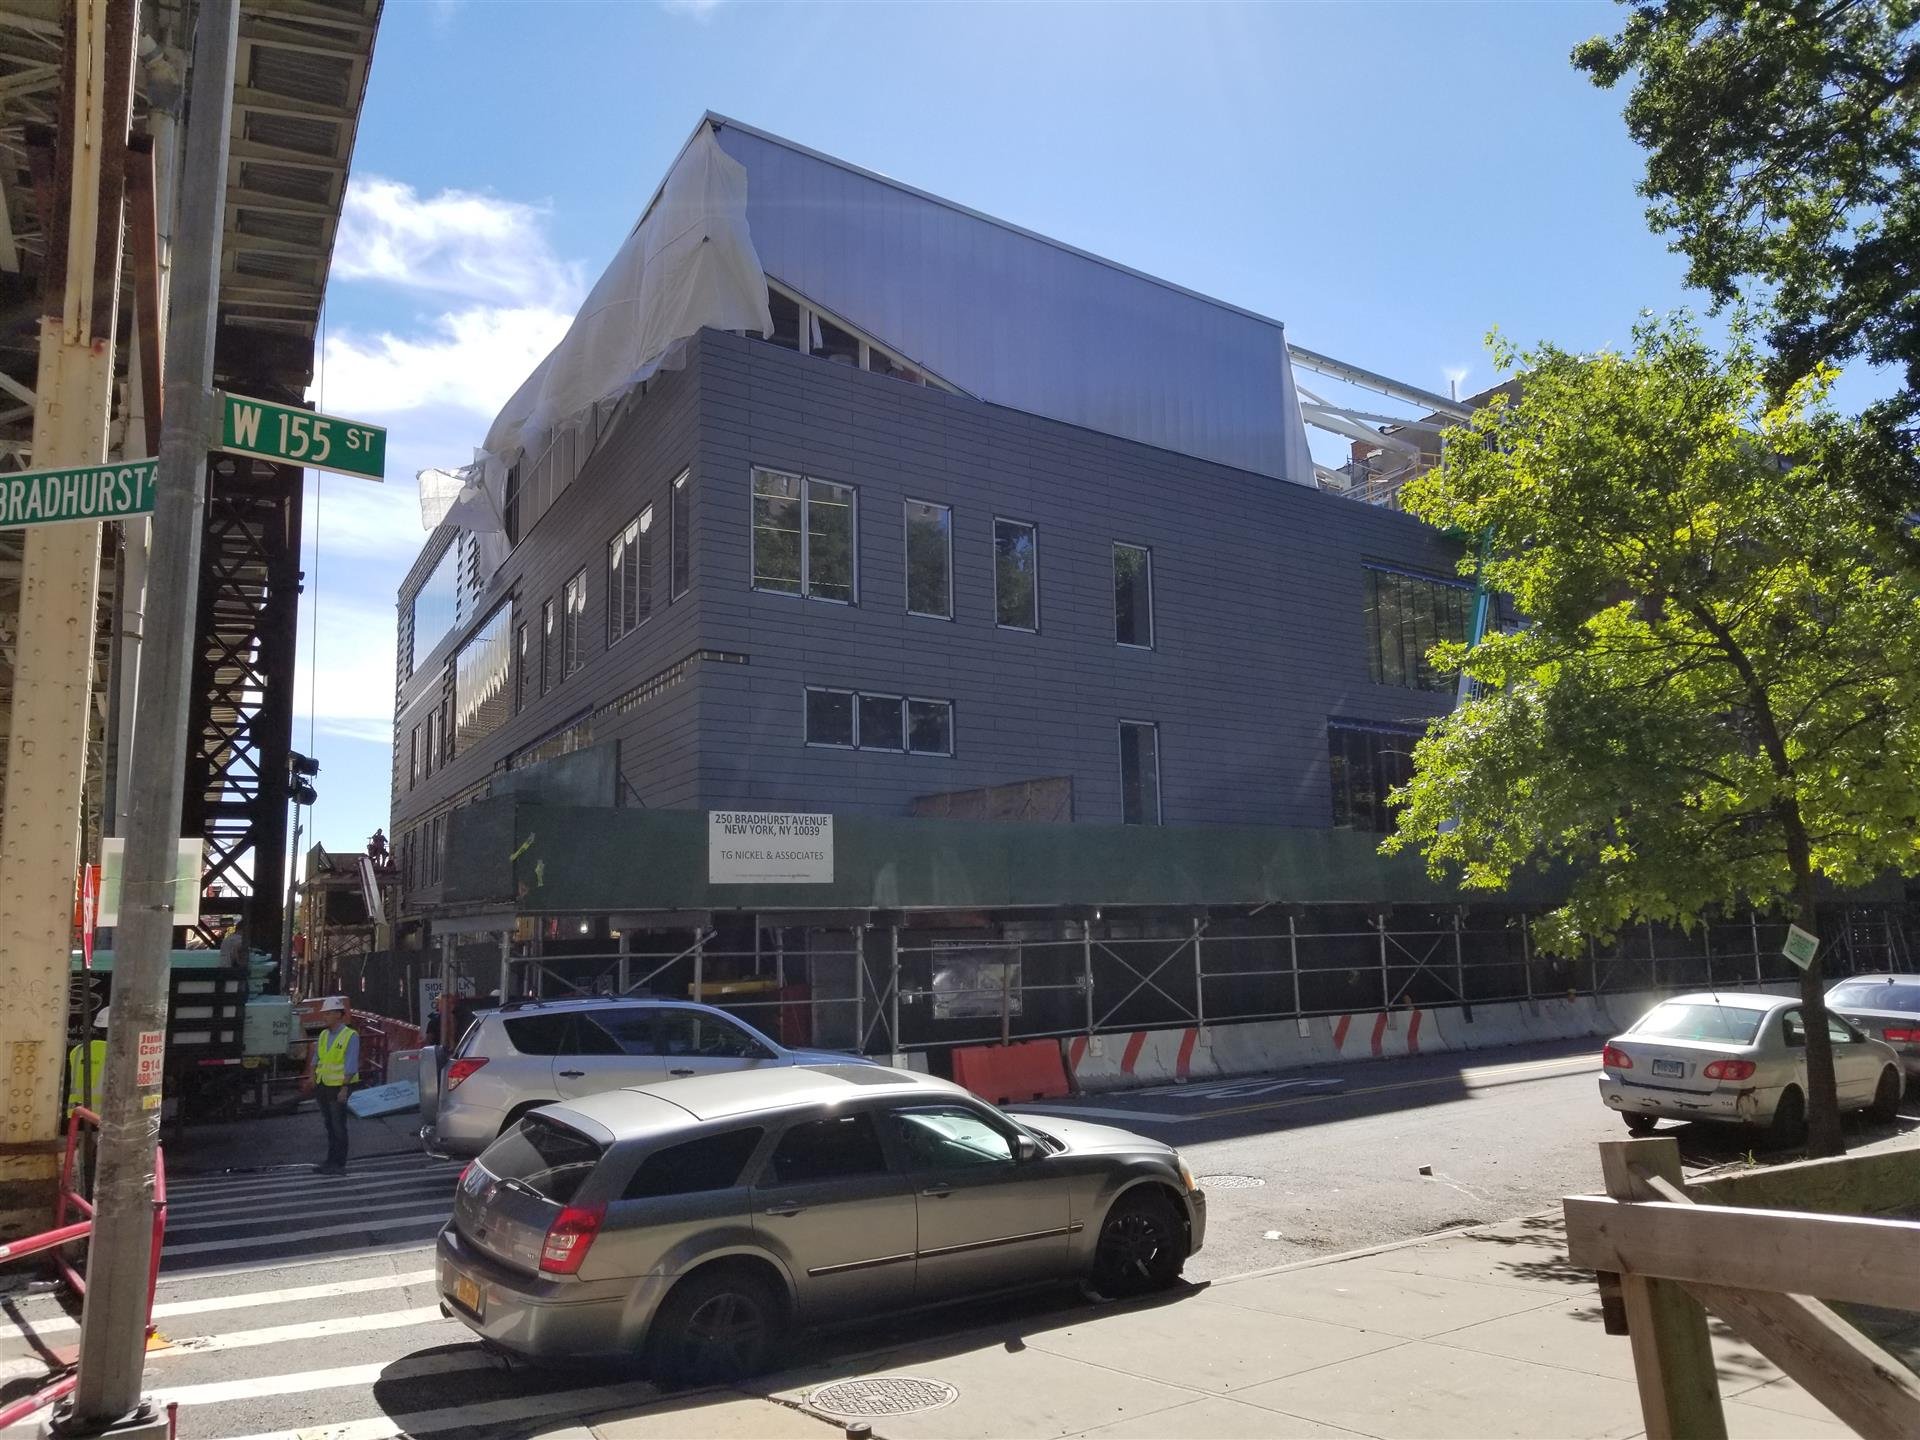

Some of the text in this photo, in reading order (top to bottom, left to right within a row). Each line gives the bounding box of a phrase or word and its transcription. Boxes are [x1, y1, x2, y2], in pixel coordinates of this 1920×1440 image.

[233, 403, 376, 462] W 155 ST
[715, 814, 828, 826] 250 BRADHURST AVENUE
[724, 825, 820, 837] NEW YORK, NY 10039
[721, 851, 824, 861] TG NICKEL & ASSOCIATES
[425, 982, 470, 991] SIDELK
[140, 1045, 164, 1056] Cars
[141, 1060, 161, 1072] 914
